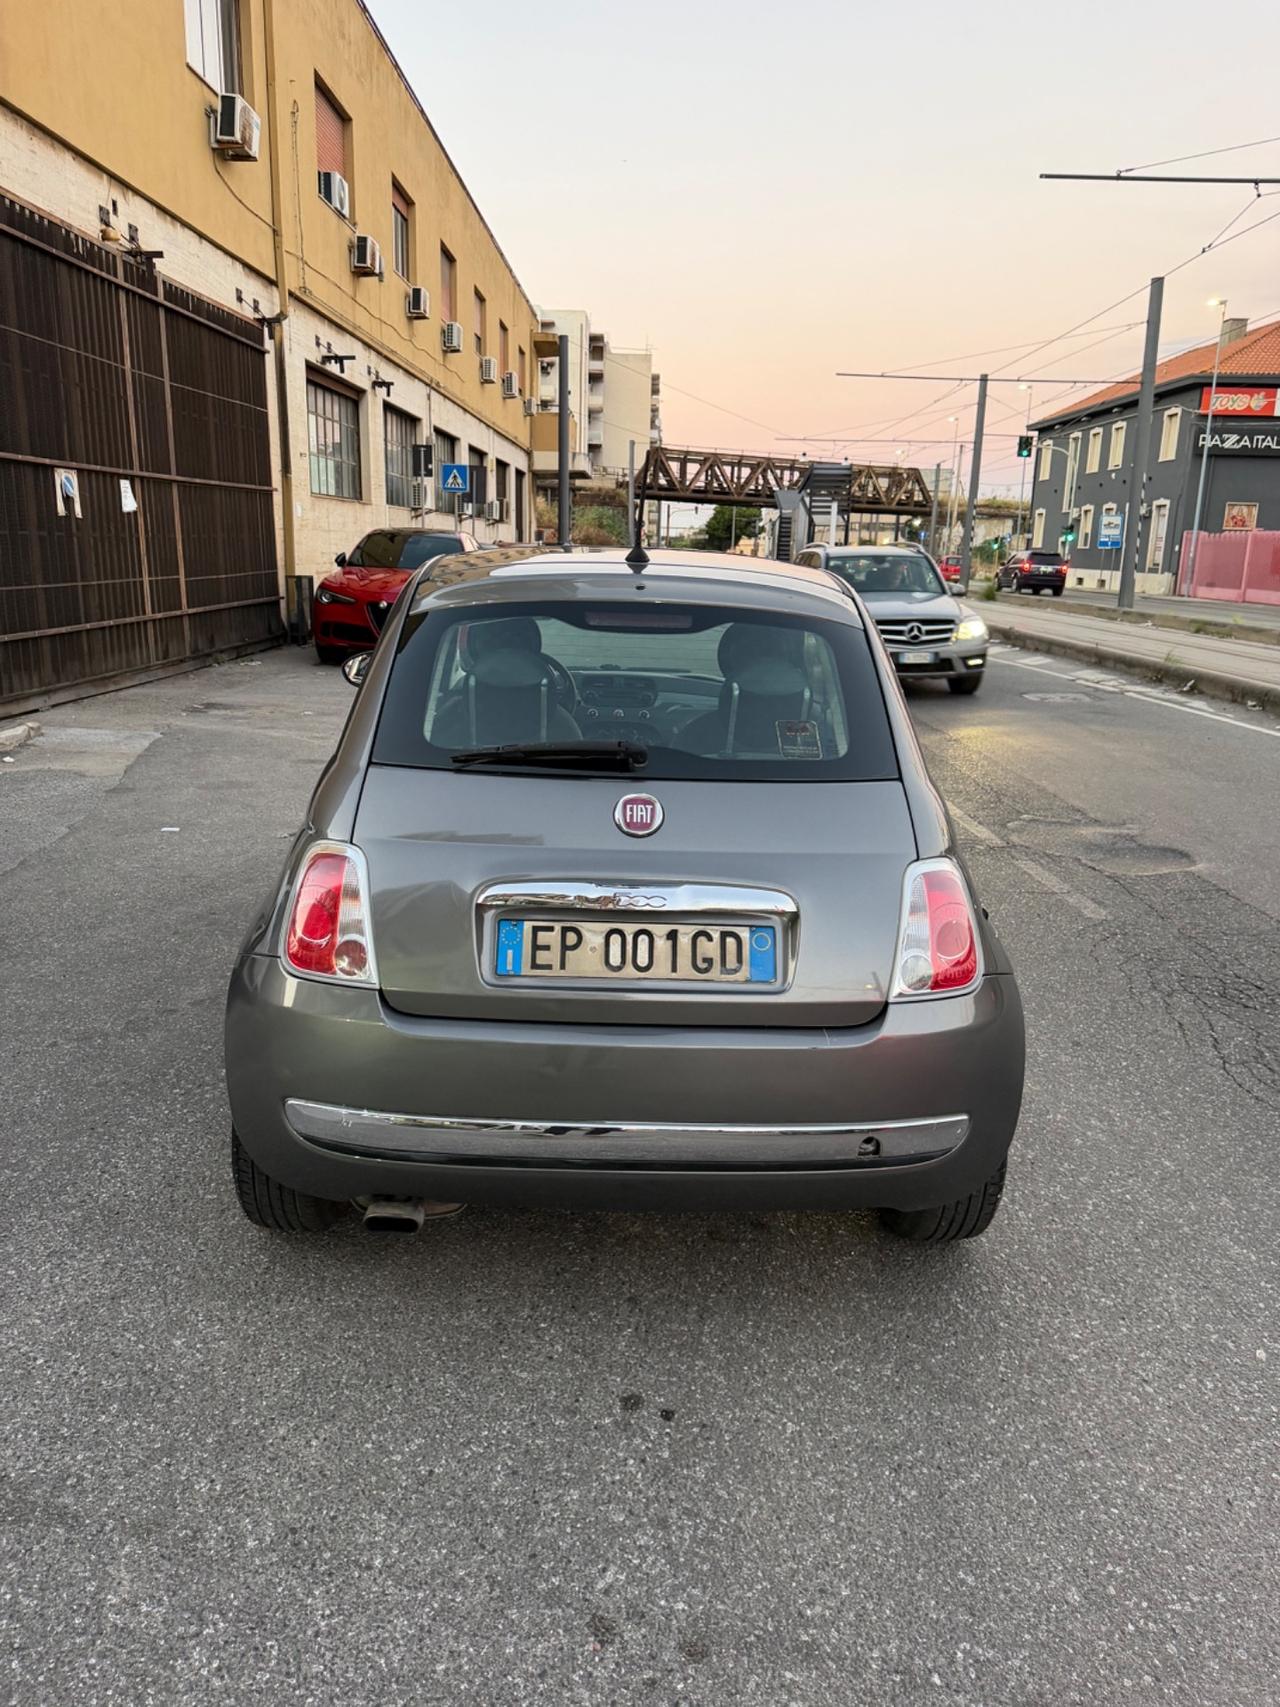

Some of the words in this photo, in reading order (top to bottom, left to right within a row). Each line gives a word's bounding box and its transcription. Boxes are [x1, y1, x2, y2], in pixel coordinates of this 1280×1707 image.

[1211, 394, 1251, 411] TOYS
[1252, 435, 1280, 449] ITAL
[626, 804, 653, 823] FIAT
[530, 925, 583, 970] EP
[604, 928, 743, 975] 001GD
